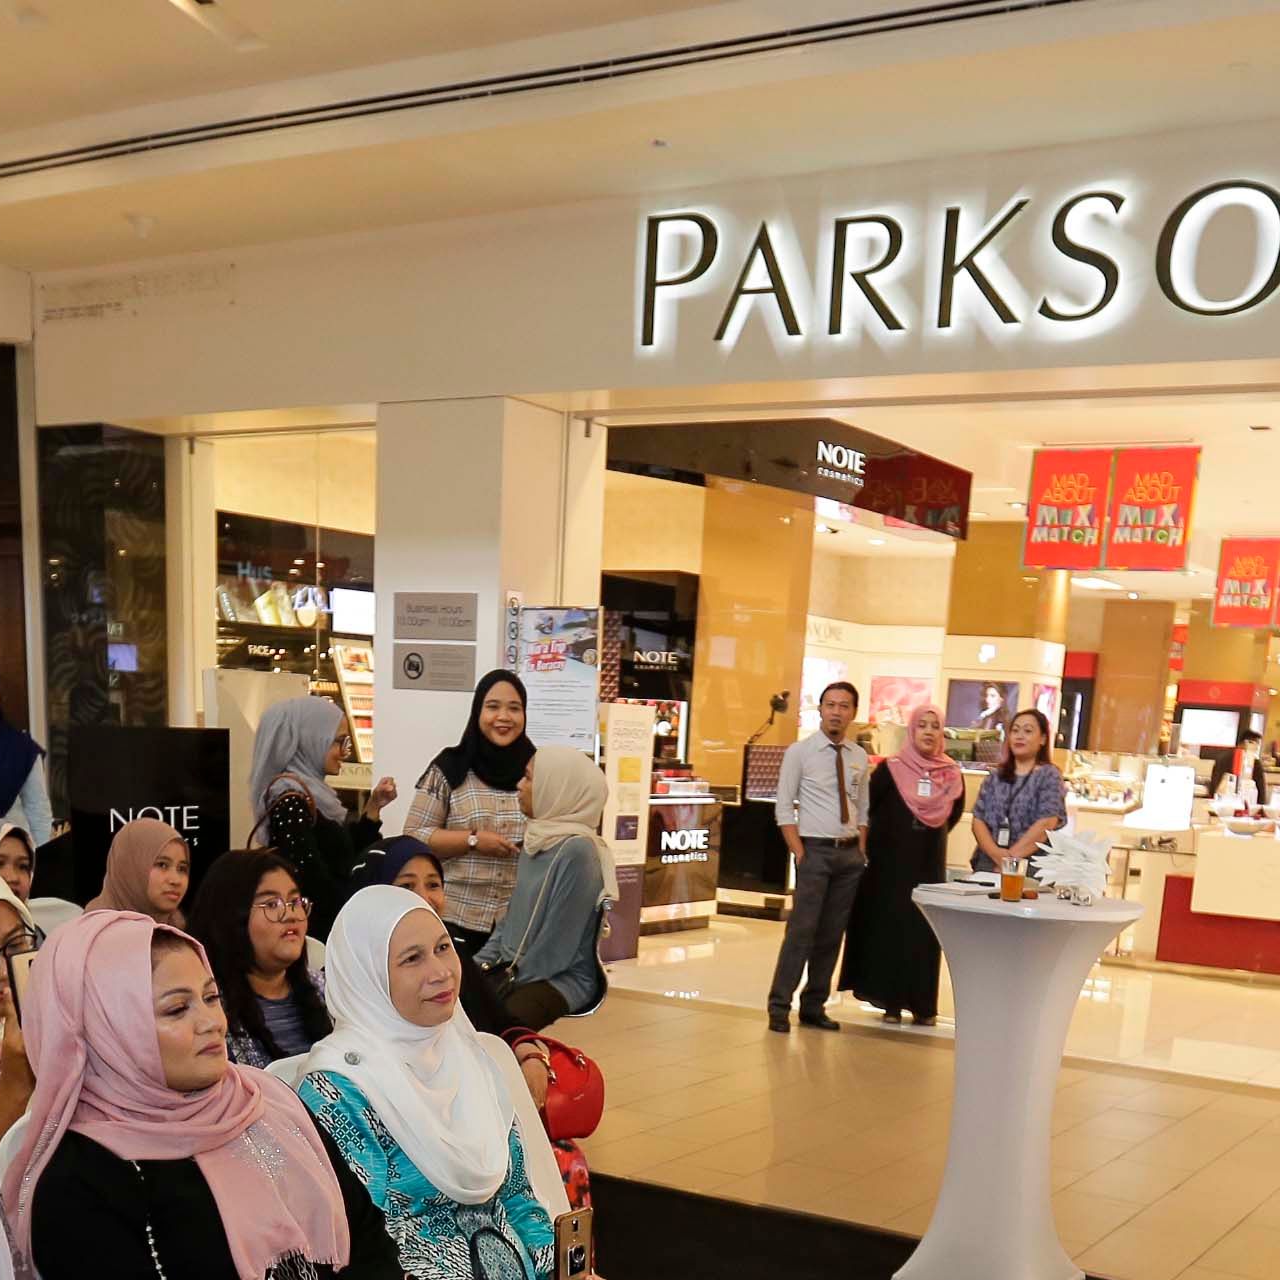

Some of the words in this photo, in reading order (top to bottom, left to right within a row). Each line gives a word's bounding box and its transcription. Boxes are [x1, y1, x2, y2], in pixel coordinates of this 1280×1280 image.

[817, 440, 866, 475] NOTE
[1051, 473, 1090, 488] MAD
[1135, 472, 1174, 487] MAD
[1041, 487, 1097, 503] ABOUT
[1125, 486, 1182, 502] ABOUT
[633, 650, 679, 664] NOTE
[661, 828, 710, 850] NOTE
